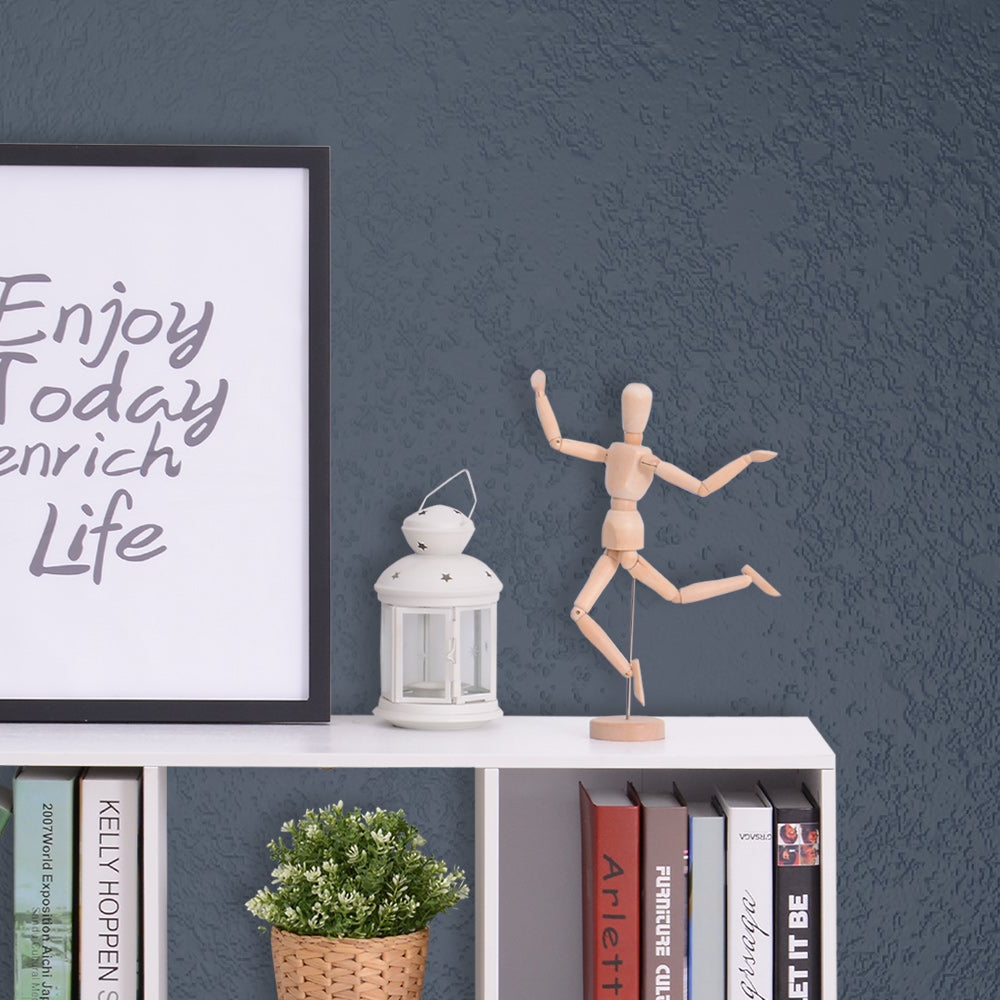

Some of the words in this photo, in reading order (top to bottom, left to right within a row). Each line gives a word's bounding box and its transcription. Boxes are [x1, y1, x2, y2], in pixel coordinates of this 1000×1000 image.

[29, 489, 167, 585] Life
[98, 800, 120, 873] KELLY
[40, 874, 53, 941] Exposition
[98, 881, 119, 981] HOPPEN
[788, 894, 809, 928] BE
[42, 945, 53, 977] Aichi
[788, 935, 809, 959] IT
